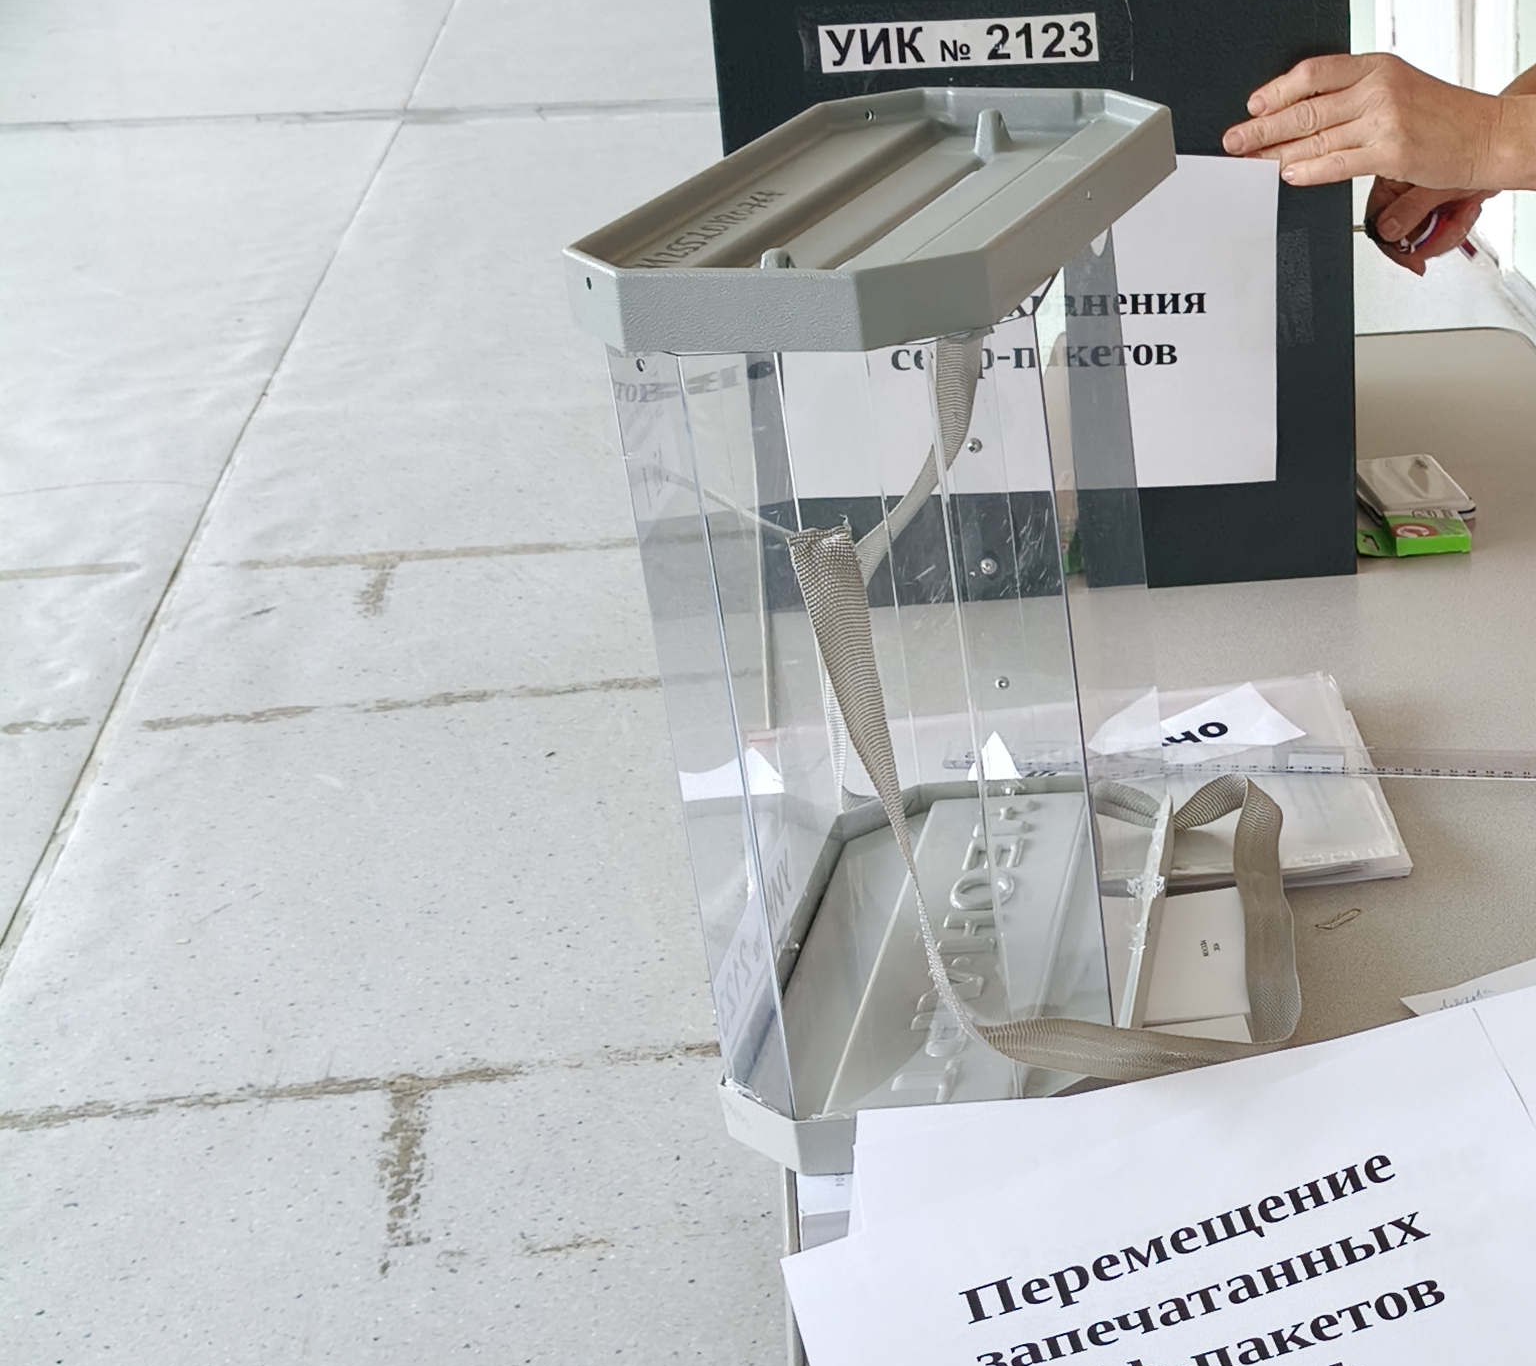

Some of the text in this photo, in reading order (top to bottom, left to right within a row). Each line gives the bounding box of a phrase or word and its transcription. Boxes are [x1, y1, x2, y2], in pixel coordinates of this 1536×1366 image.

[825, 21, 1094, 67] УИК № 2123
[958, 1153, 1397, 1324] Перемещение
